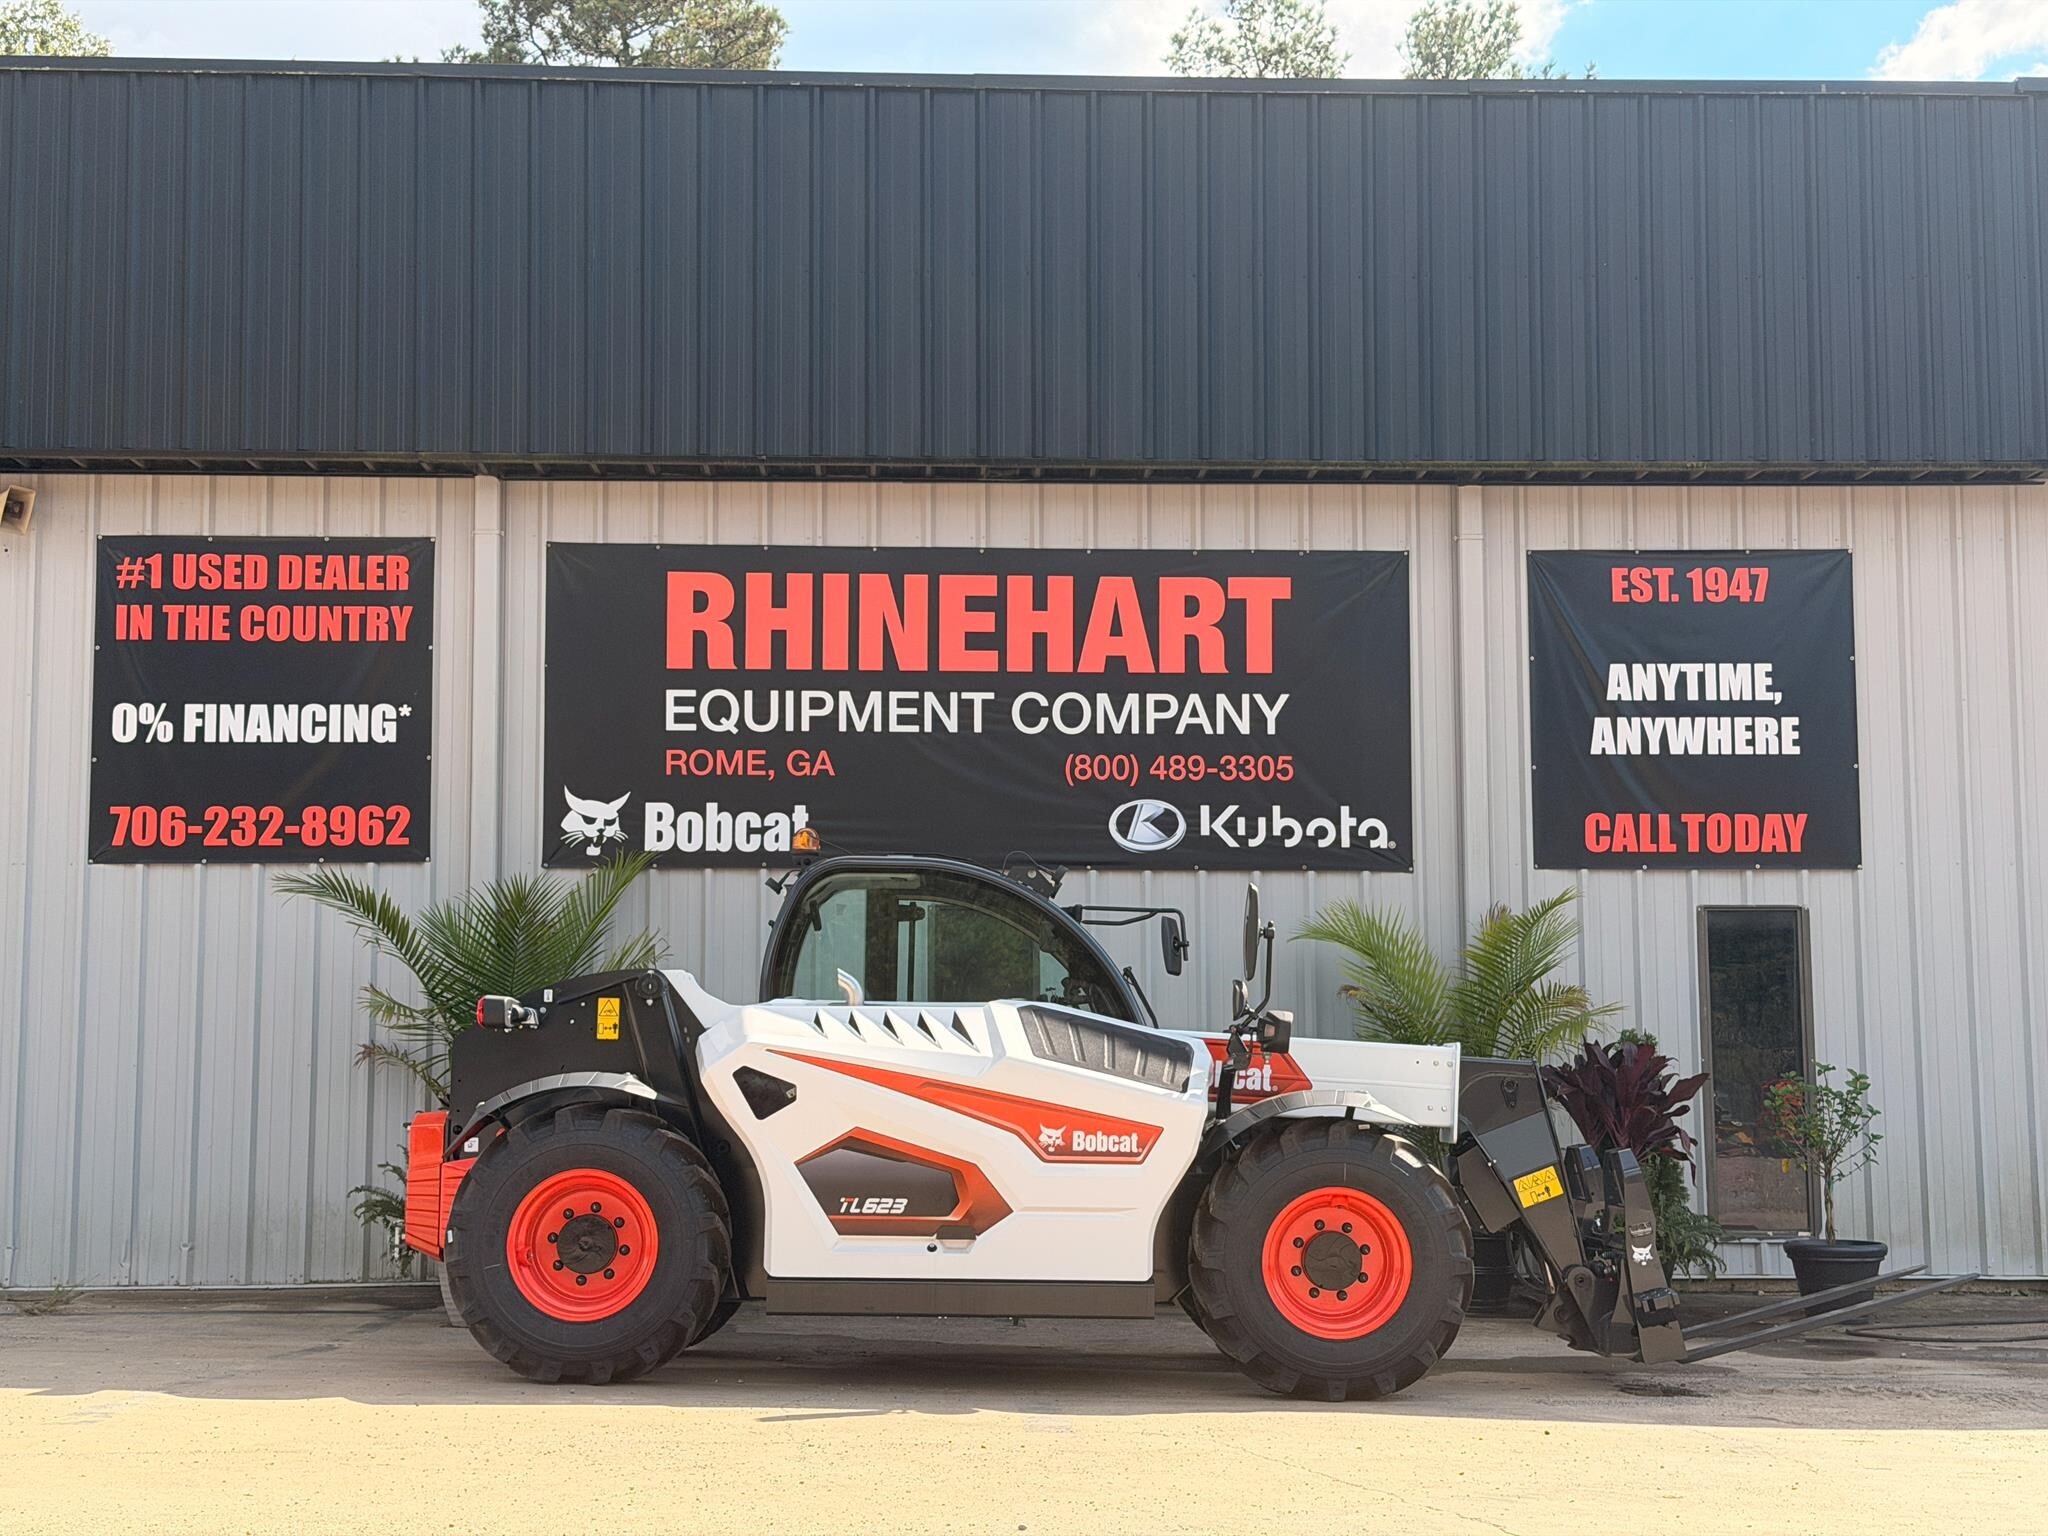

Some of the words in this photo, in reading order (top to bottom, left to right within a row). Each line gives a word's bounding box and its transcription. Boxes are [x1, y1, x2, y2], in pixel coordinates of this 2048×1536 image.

[116, 553, 162, 589] #1
[172, 553, 268, 590] USED
[277, 555, 410, 591] DEALER
[1611, 567, 1680, 603] EST.
[1686, 567, 1769, 603] 1947
[115, 604, 153, 640] IN
[162, 604, 230, 641] THE
[239, 605, 413, 642] COUNTRY
[665, 571, 1292, 674] RHINEHART
[1606, 663, 1782, 705] ANYTIME,
[111, 702, 173, 743] 0%
[665, 688, 995, 735] EQUIPMENT
[1011, 691, 1290, 735] COMPANY
[1590, 717, 1801, 755] ANYWHERE
[665, 749, 775, 781] ROME,
[786, 750, 836, 777] GA
[1064, 754, 1140, 787] (800)
[1149, 755, 1295, 782] 489-3305
[109, 805, 411, 847] 706-232-8962
[644, 802, 809, 852] Bobcat
[1199, 804, 1388, 849] Kubota
[1584, 812, 1677, 853] CALL
[1681, 813, 1808, 853] TODAY
[1072, 1130, 1138, 1153] Bobcat
[840, 1197, 908, 1214] TL623
